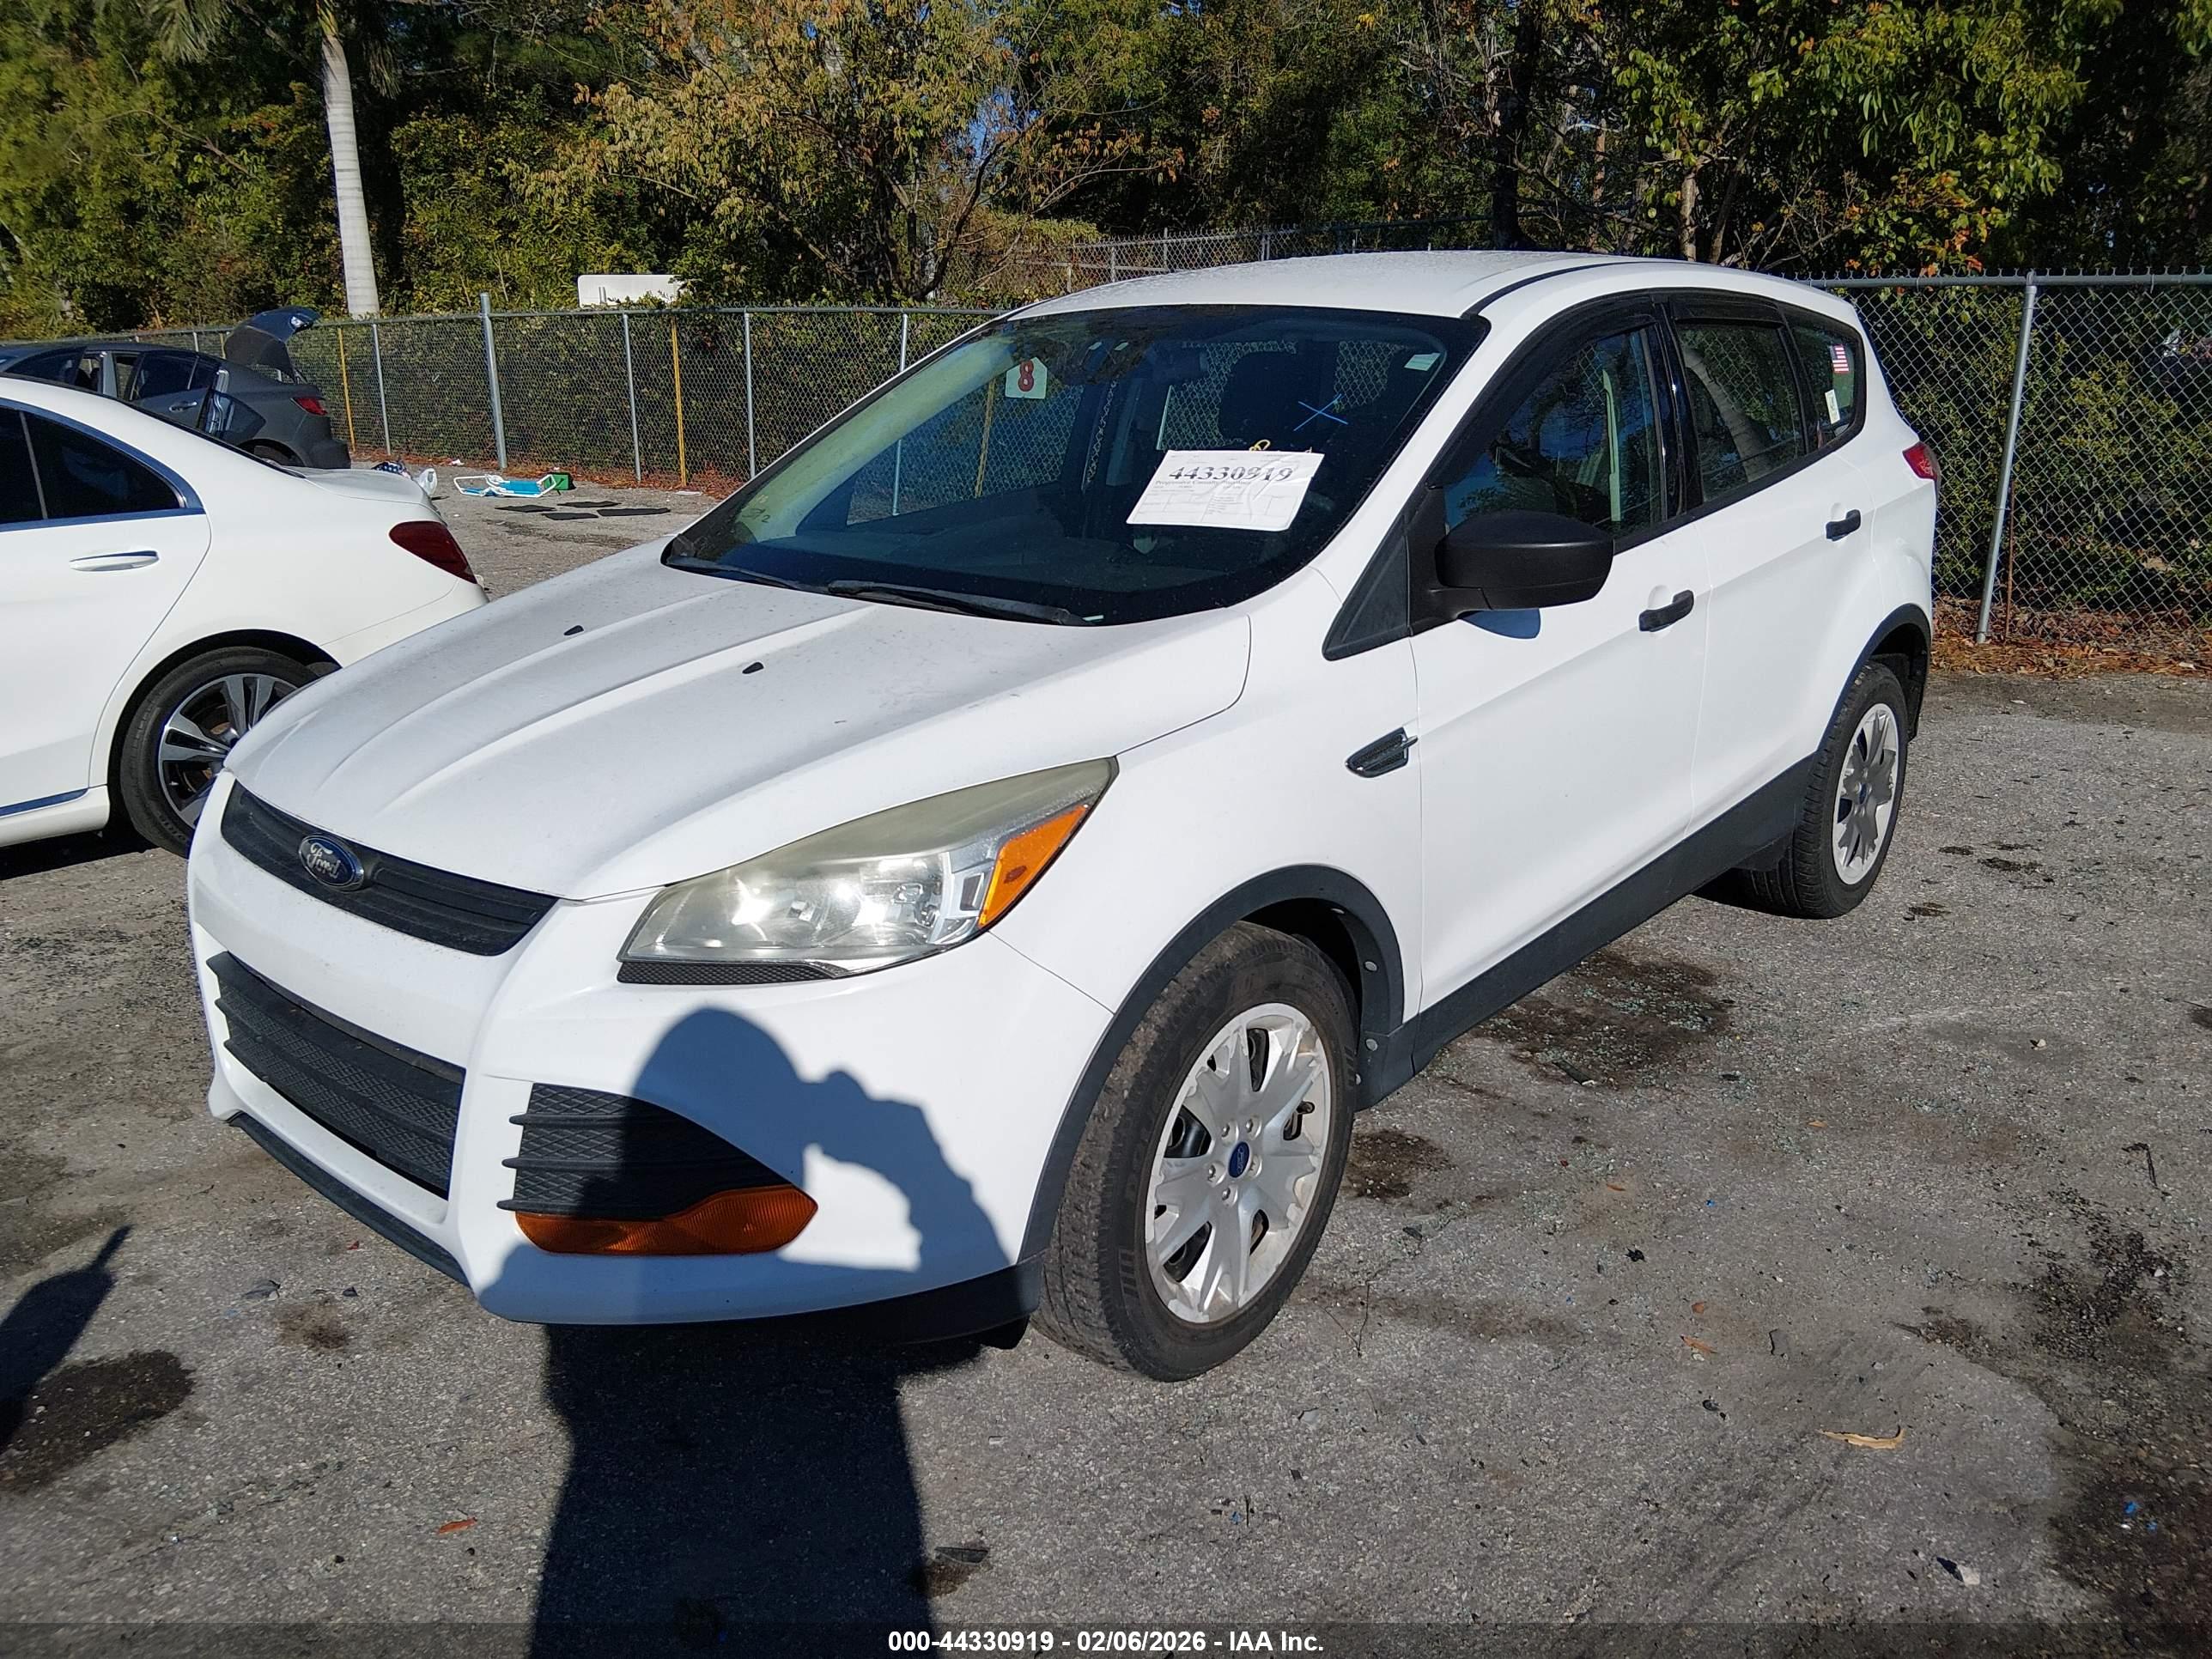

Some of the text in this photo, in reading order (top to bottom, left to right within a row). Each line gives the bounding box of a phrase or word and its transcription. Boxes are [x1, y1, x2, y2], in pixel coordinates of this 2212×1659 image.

[1018, 359, 1035, 392] 8
[1169, 466, 1293, 482] 44330919
[307, 842, 342, 879] Ford
